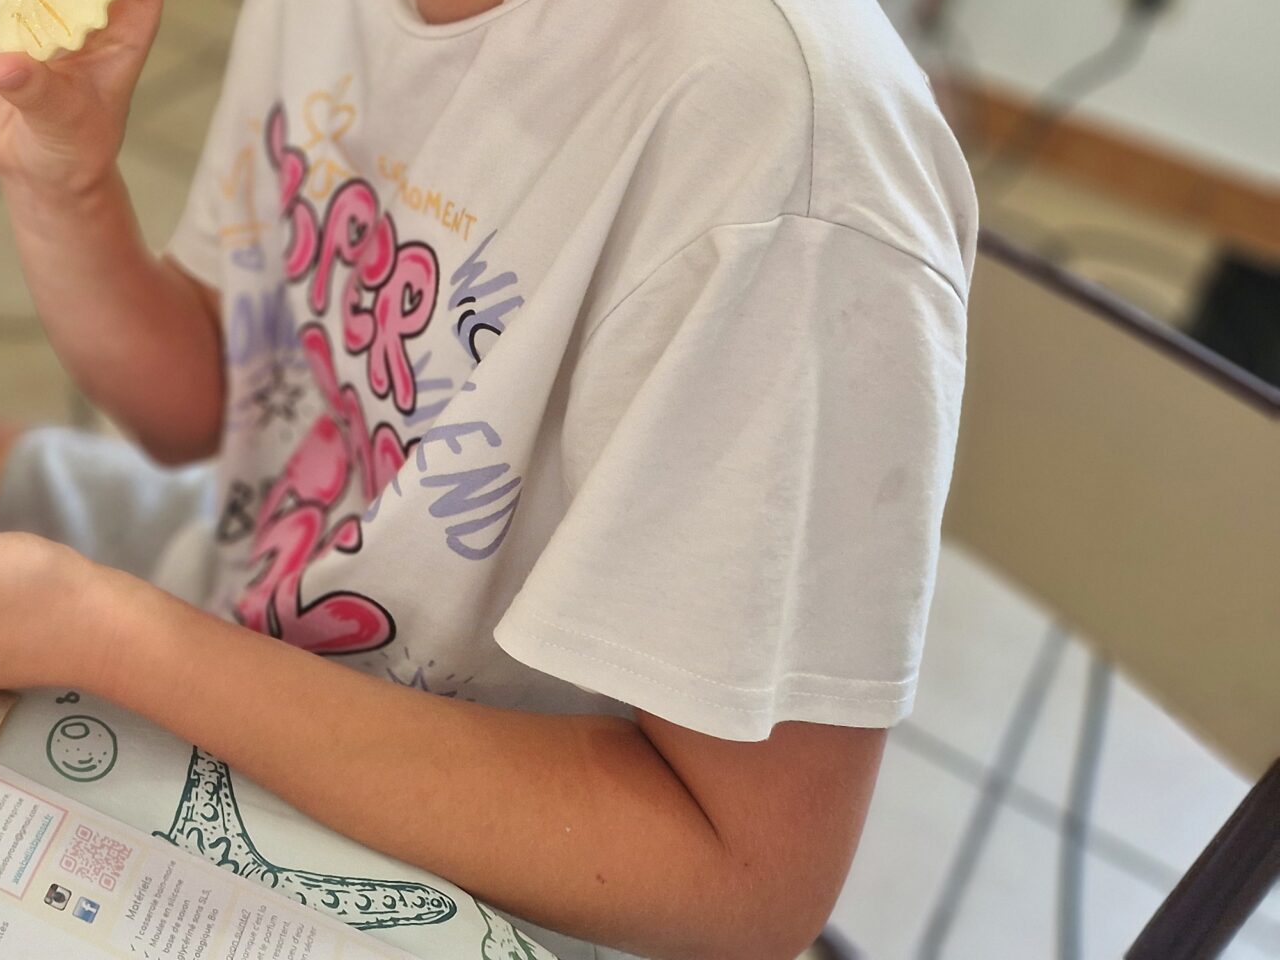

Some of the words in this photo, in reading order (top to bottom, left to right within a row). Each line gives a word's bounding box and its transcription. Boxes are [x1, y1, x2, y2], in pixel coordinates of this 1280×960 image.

[125, 876, 152, 920] Matériels
[139, 899, 158, 936] casserole
[155, 860, 176, 898] bain-marie
[167, 879, 184, 907] silicone
[162, 934, 176, 954] base
[172, 921, 181, 933] de
[177, 899, 191, 921] savon
[163, 907, 172, 918] en
[207, 908, 219, 921] Bio
[149, 919, 167, 948] Moules
[264, 915, 278, 944] parfum
